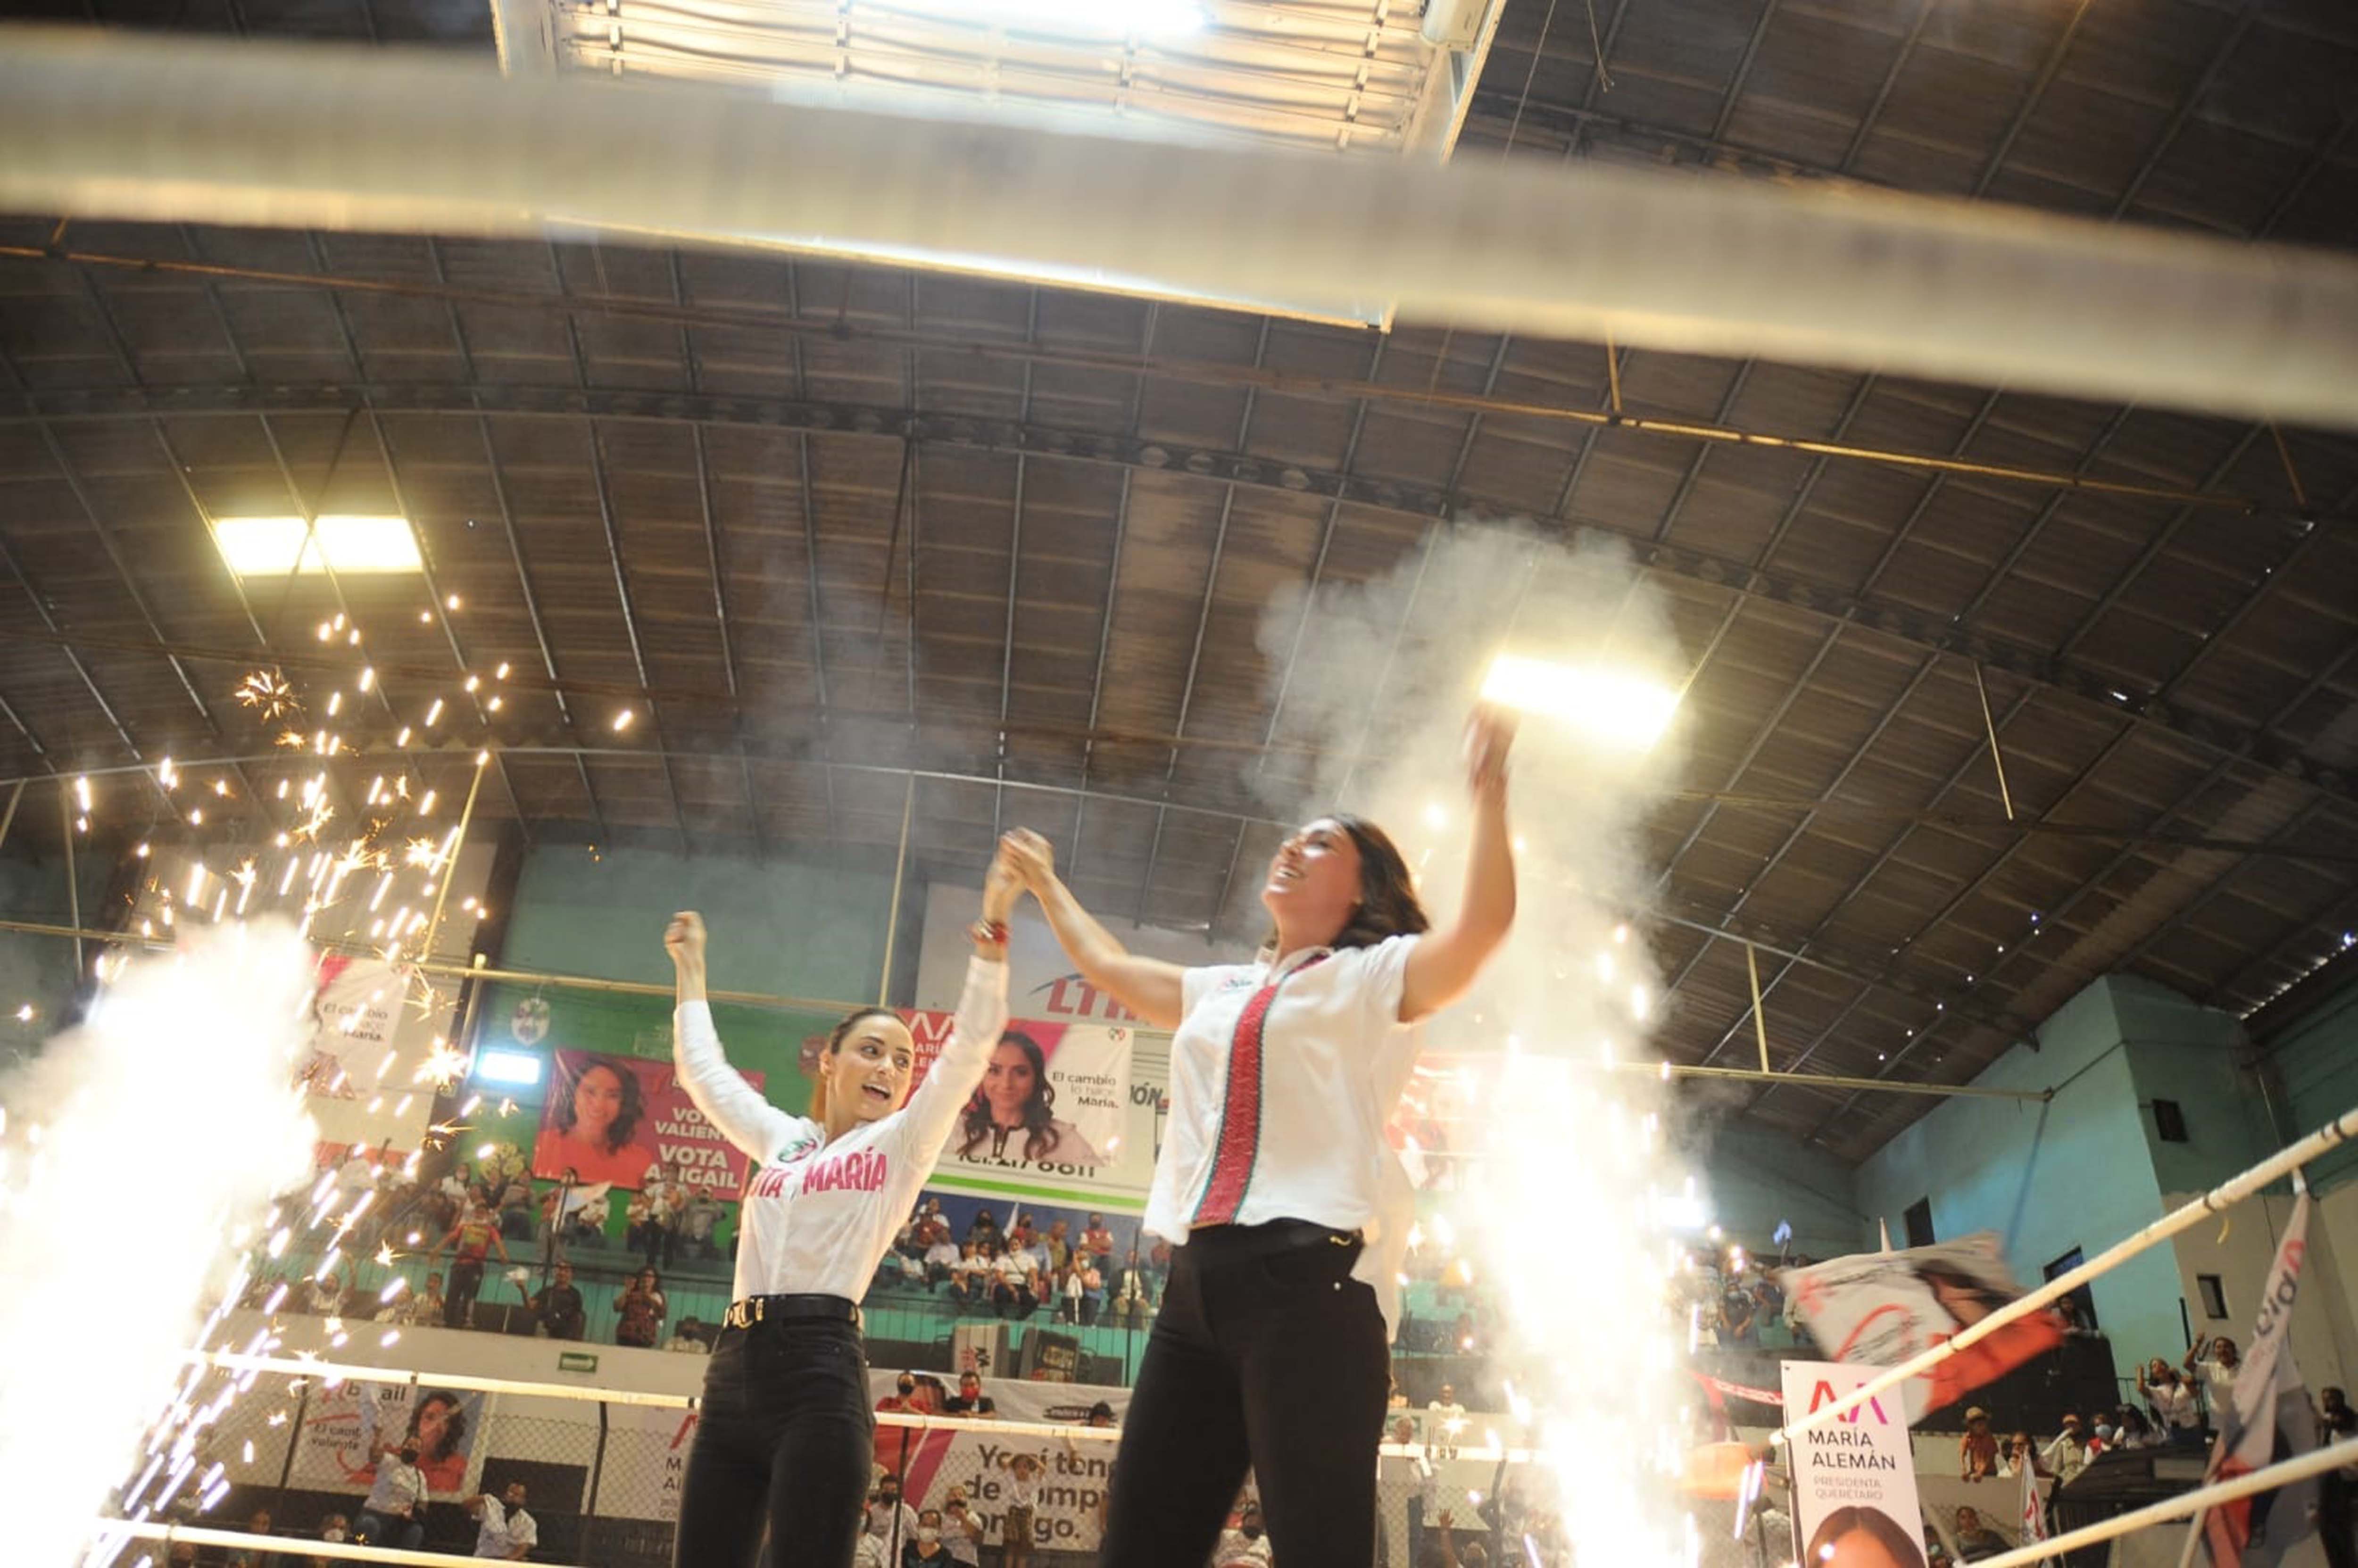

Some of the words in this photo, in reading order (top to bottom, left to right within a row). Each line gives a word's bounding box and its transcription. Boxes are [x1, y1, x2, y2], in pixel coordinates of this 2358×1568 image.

[1052, 1072, 1064, 1082] El
[1067, 1073, 1116, 1086] cambio
[1078, 1096, 1119, 1109] María.
[655, 1120, 730, 1140] VALIEN
[658, 1143, 728, 1168] VOTA
[644, 1163, 739, 1188] AIGAIL
[803, 1145, 887, 1195] MARÍA
[1808, 1427, 1873, 1447] MARÍA
[1812, 1450, 1896, 1470] ALEMÁN
[964, 1474, 1001, 1500] de
